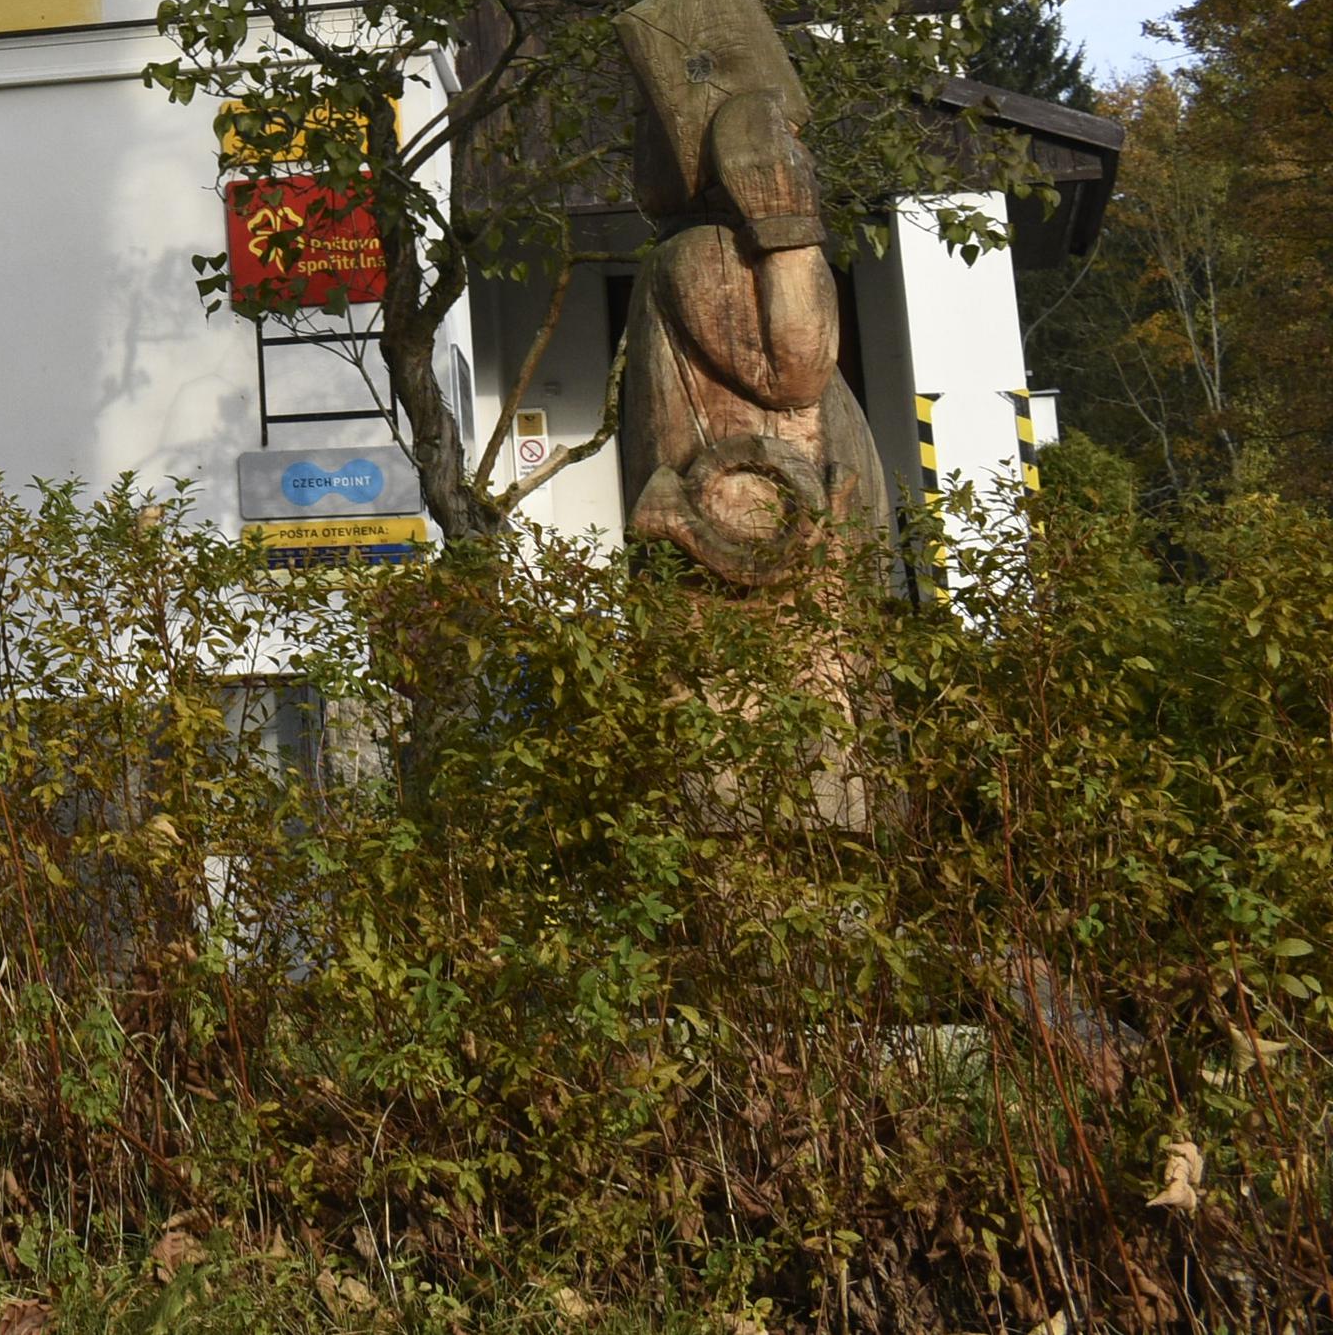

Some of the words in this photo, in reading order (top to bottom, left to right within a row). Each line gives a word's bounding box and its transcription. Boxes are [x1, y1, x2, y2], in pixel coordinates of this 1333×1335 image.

[309, 236, 380, 254] Poštovn
[279, 527, 319, 539] POŠTA
[321, 525, 390, 539] OTEVŘENA:
